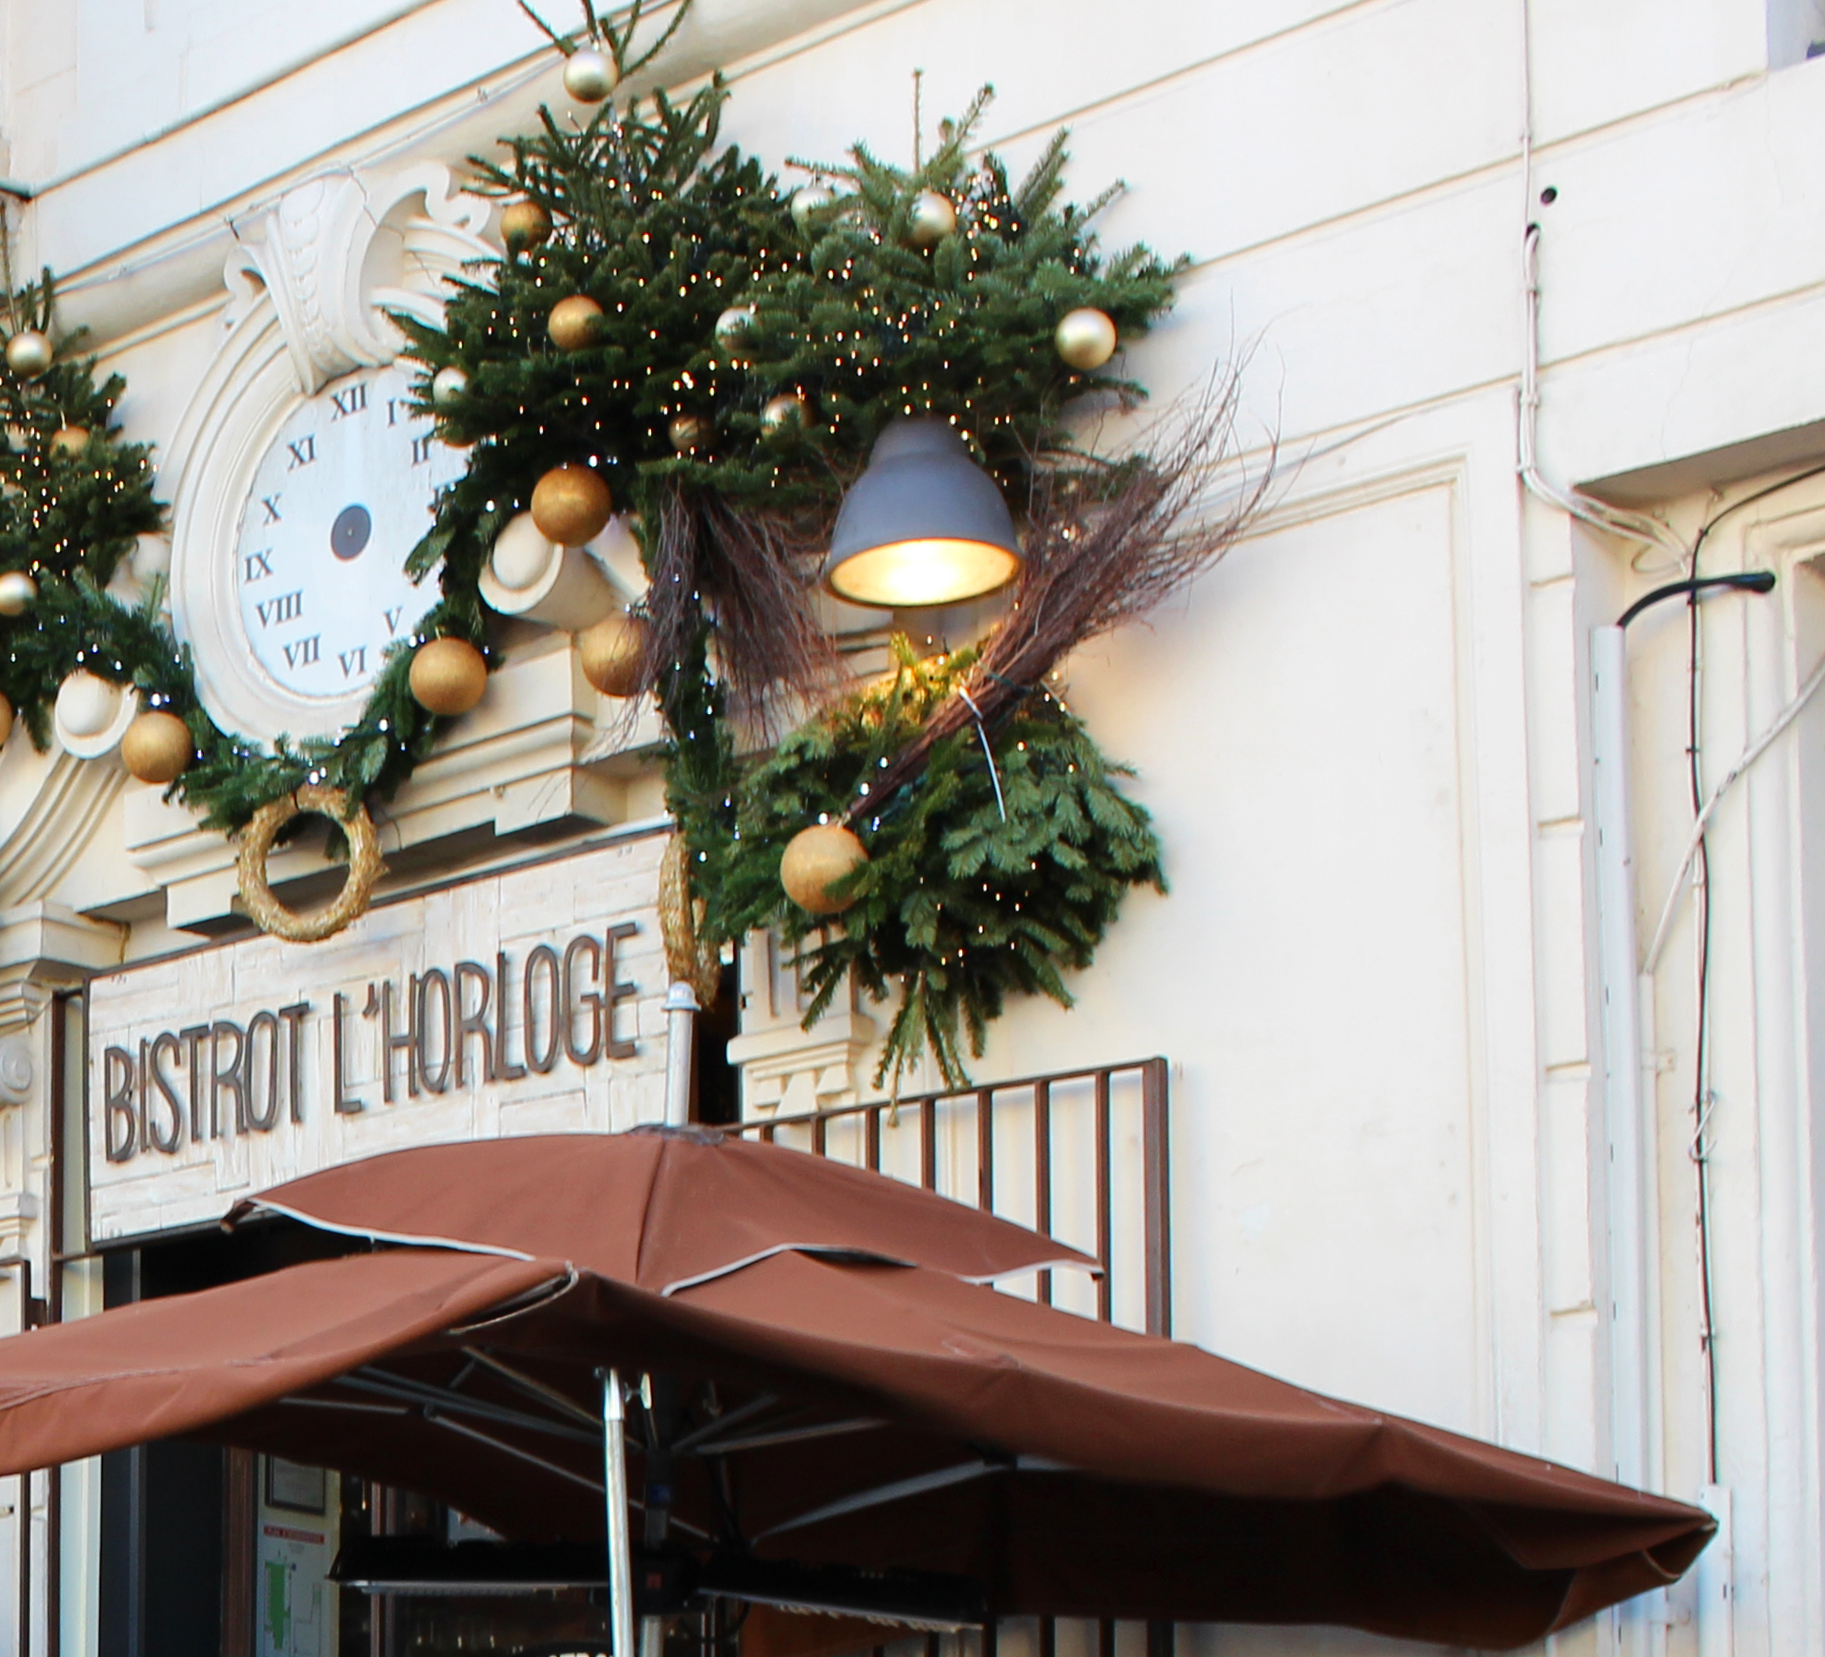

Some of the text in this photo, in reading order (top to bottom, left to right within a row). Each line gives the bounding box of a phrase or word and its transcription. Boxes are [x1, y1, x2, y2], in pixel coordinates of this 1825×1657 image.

[330, 383, 368, 421] XII
[387, 401, 398, 428] I
[287, 434, 317, 471] XI
[262, 493, 282, 526] X
[244, 548, 274, 584] IX
[255, 589, 304, 629] VIII
[383, 606, 404, 636] V
[283, 634, 321, 671] VII
[338, 646, 368, 680] VI
[104, 922, 637, 1162] BISTROT L'HORLOGE
